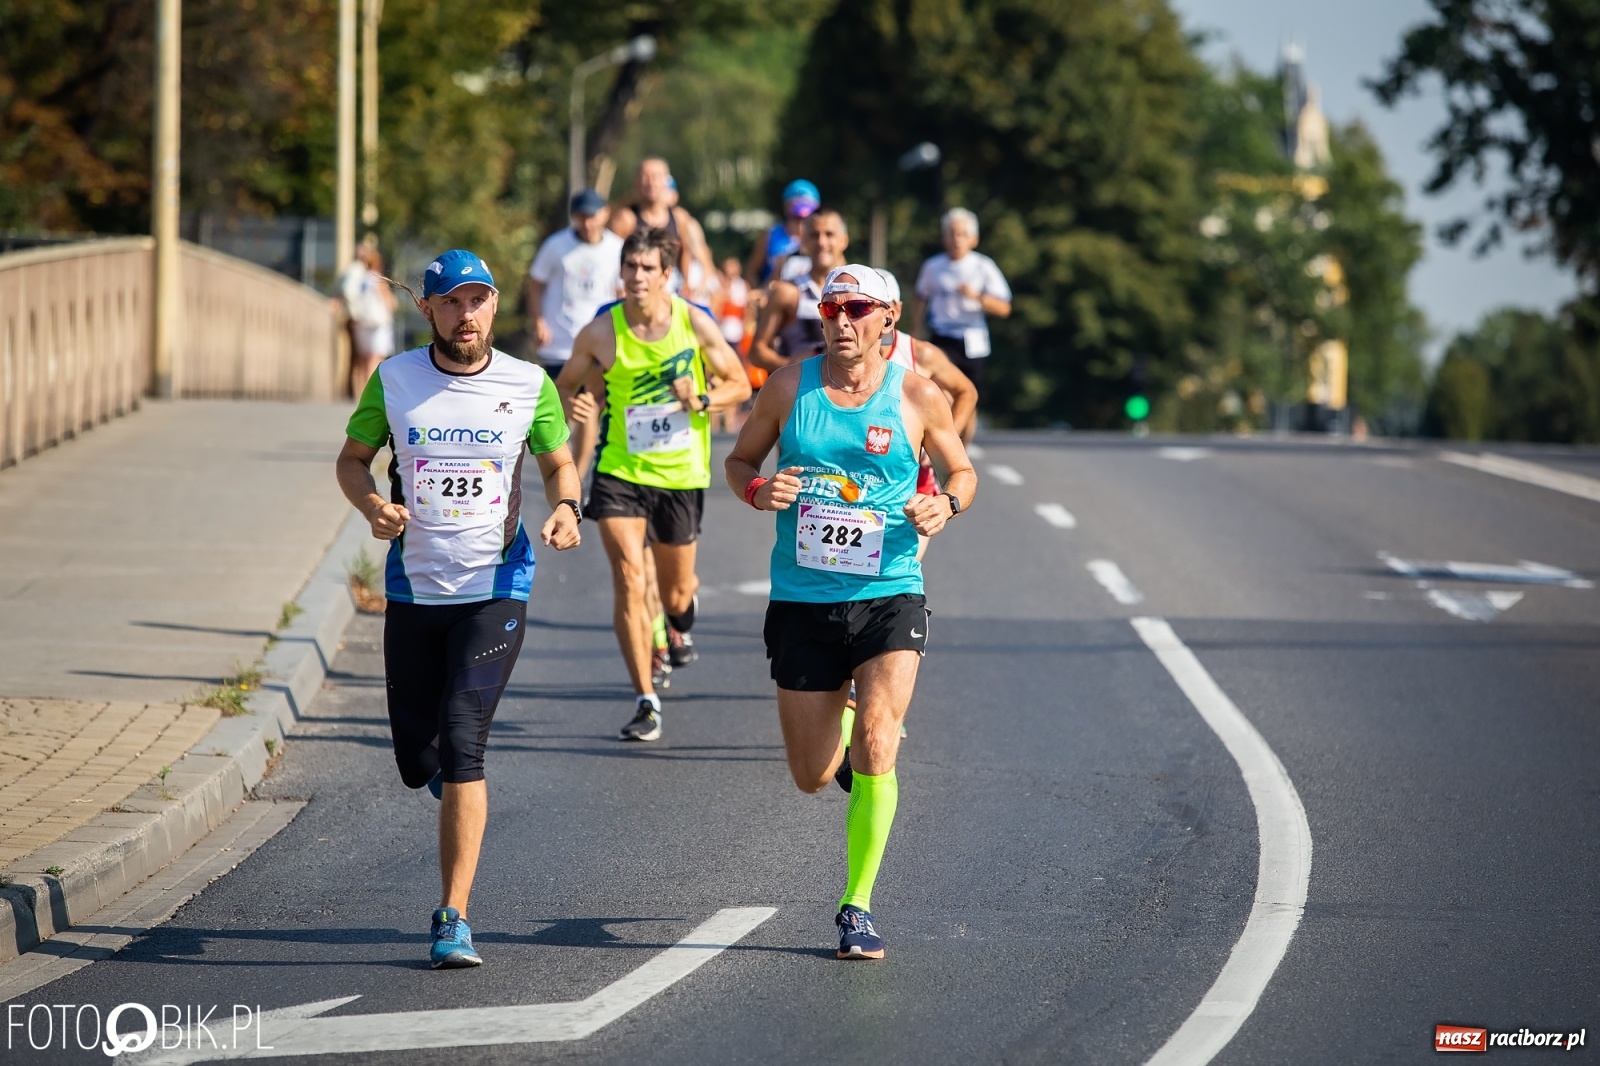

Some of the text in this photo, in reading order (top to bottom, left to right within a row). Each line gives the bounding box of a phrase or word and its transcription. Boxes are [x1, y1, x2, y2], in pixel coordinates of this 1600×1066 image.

[651, 417, 671, 433] 66
[849, 471, 885, 484] SOLARNA
[441, 477, 483, 498] 235
[821, 524, 863, 548] 282
